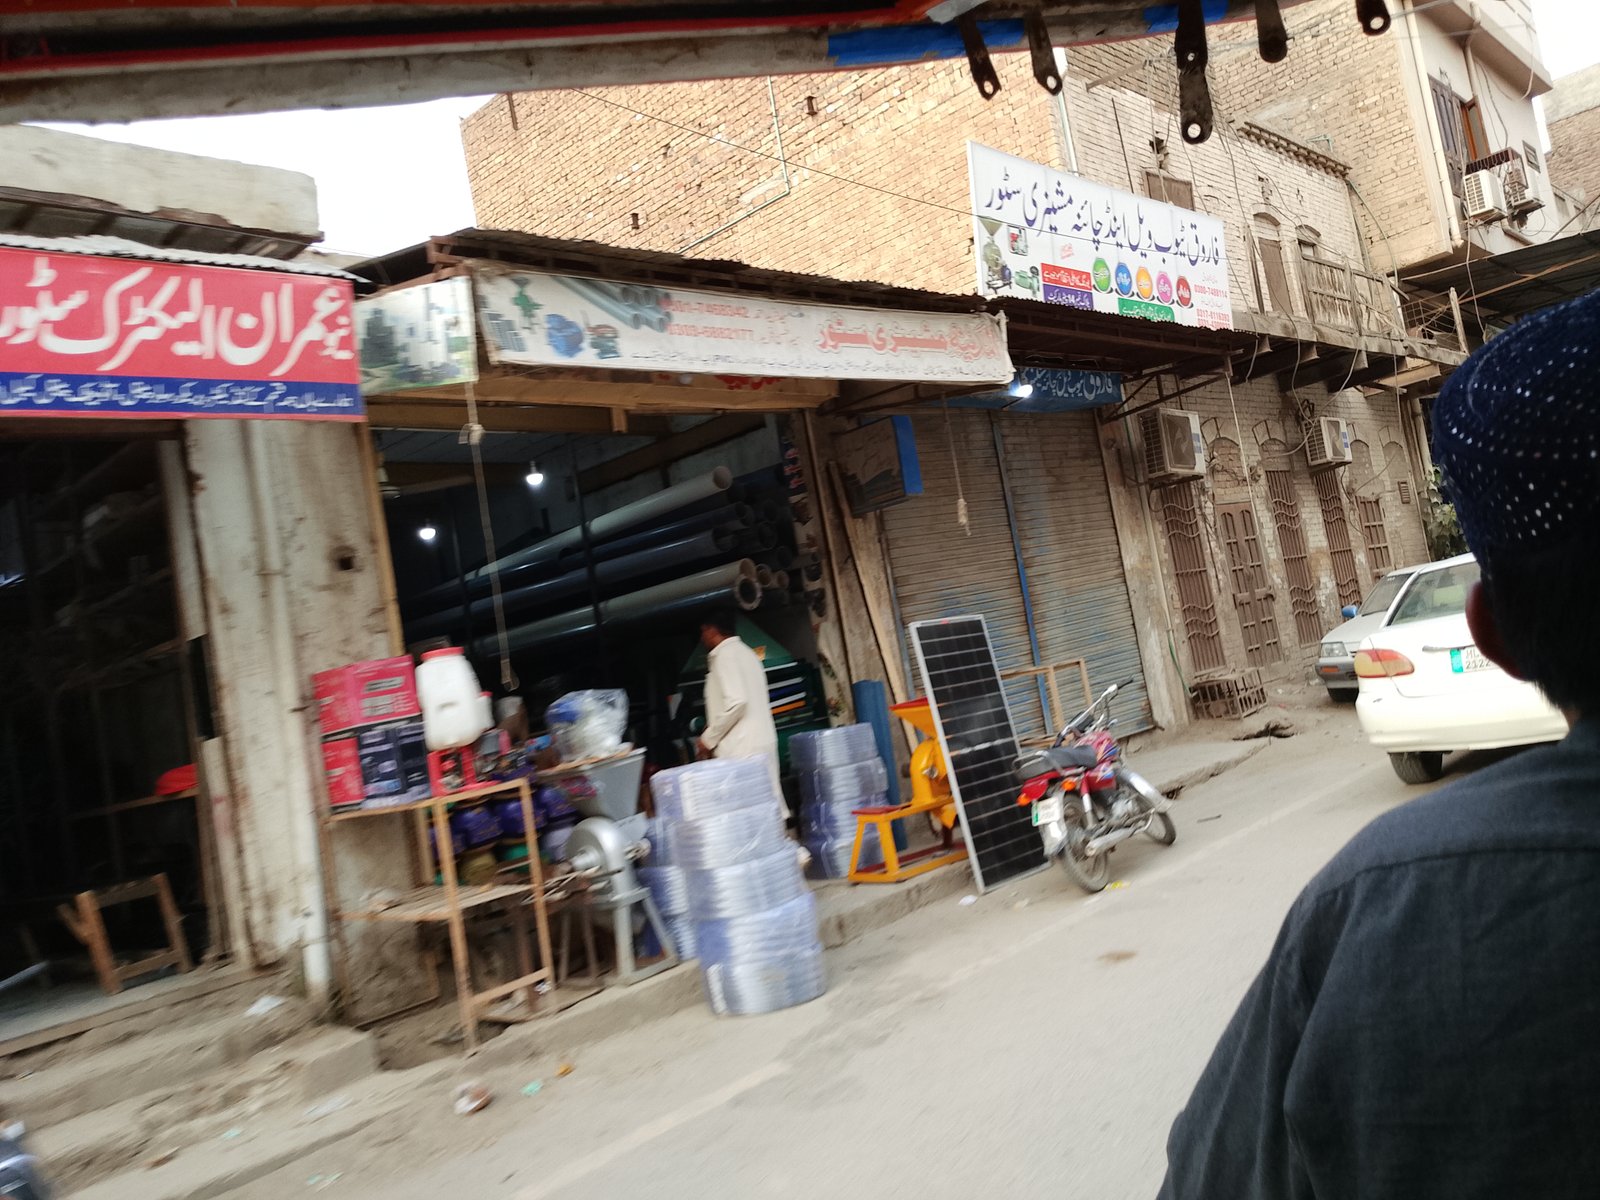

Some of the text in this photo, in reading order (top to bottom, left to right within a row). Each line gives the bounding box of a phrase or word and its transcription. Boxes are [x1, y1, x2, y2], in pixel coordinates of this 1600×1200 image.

[984, 165, 1021, 211] سٹور
[1023, 180, 1073, 237] مشینری
[1104, 199, 1127, 248] اینڈ
[1128, 202, 1153, 258] ویل
[1153, 219, 1187, 264] ٹیوب
[1187, 222, 1220, 266] فاروق
[0, 256, 89, 344] سٹور
[39, 267, 216, 371] الیکٹرک
[217, 282, 346, 376] عمران
